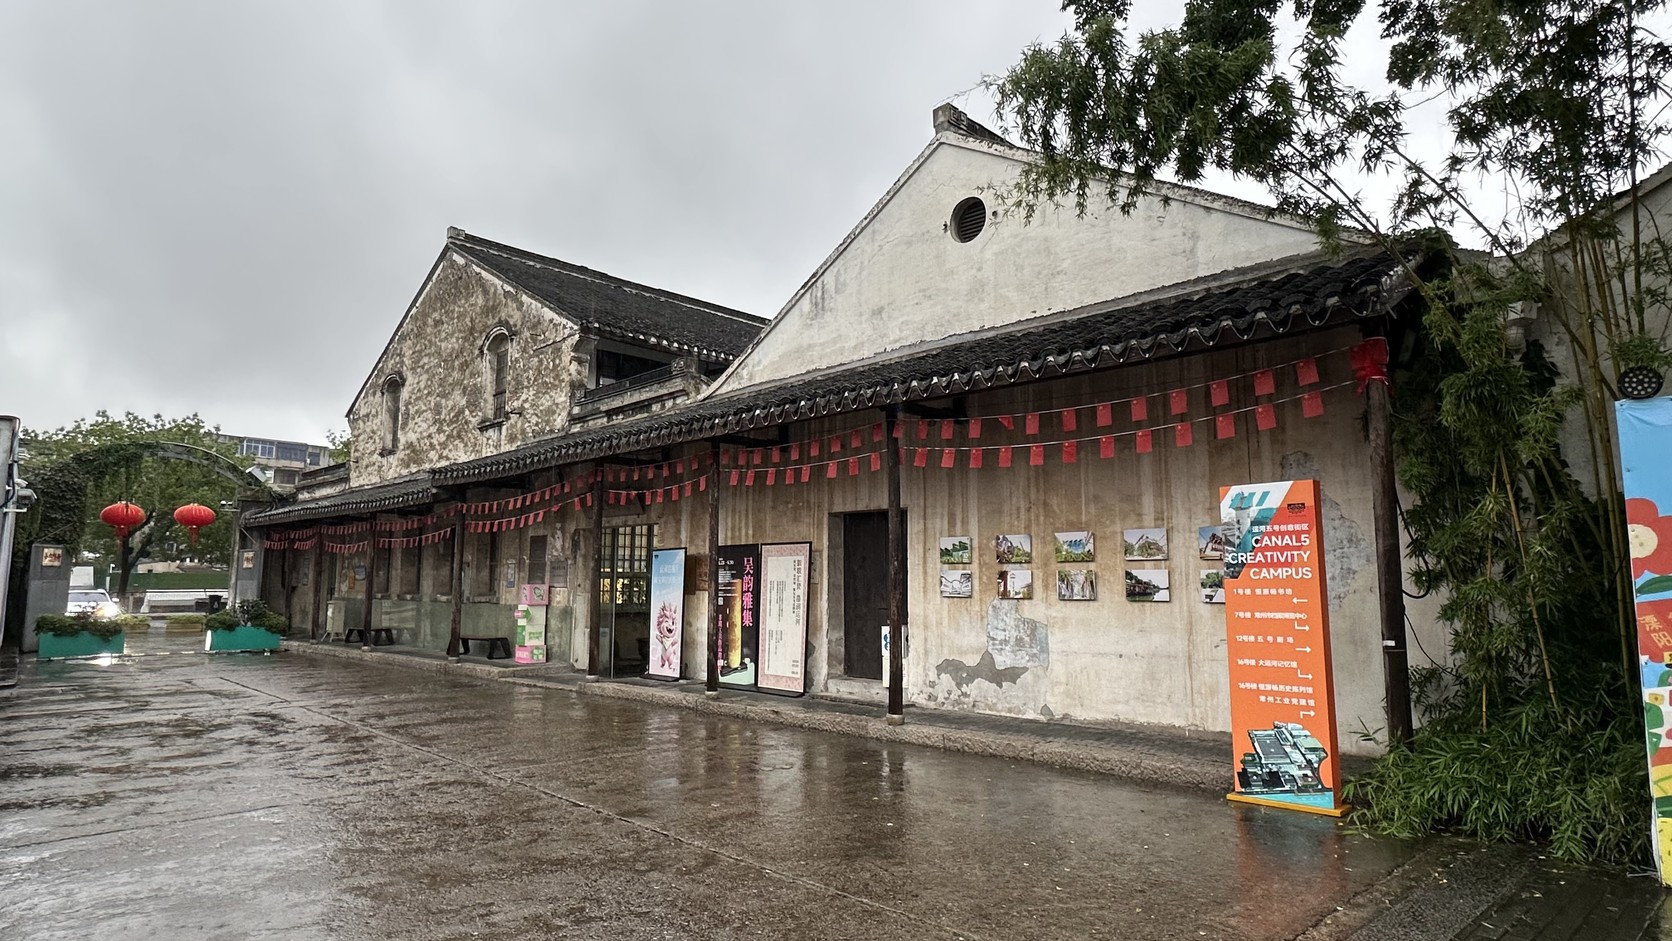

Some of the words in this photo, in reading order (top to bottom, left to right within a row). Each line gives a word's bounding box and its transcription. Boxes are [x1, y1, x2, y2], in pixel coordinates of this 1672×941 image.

[1251, 534, 1310, 547] CANAL5
[1228, 551, 1310, 564] CREATIVITY
[1249, 567, 1312, 580] CAMPUS
